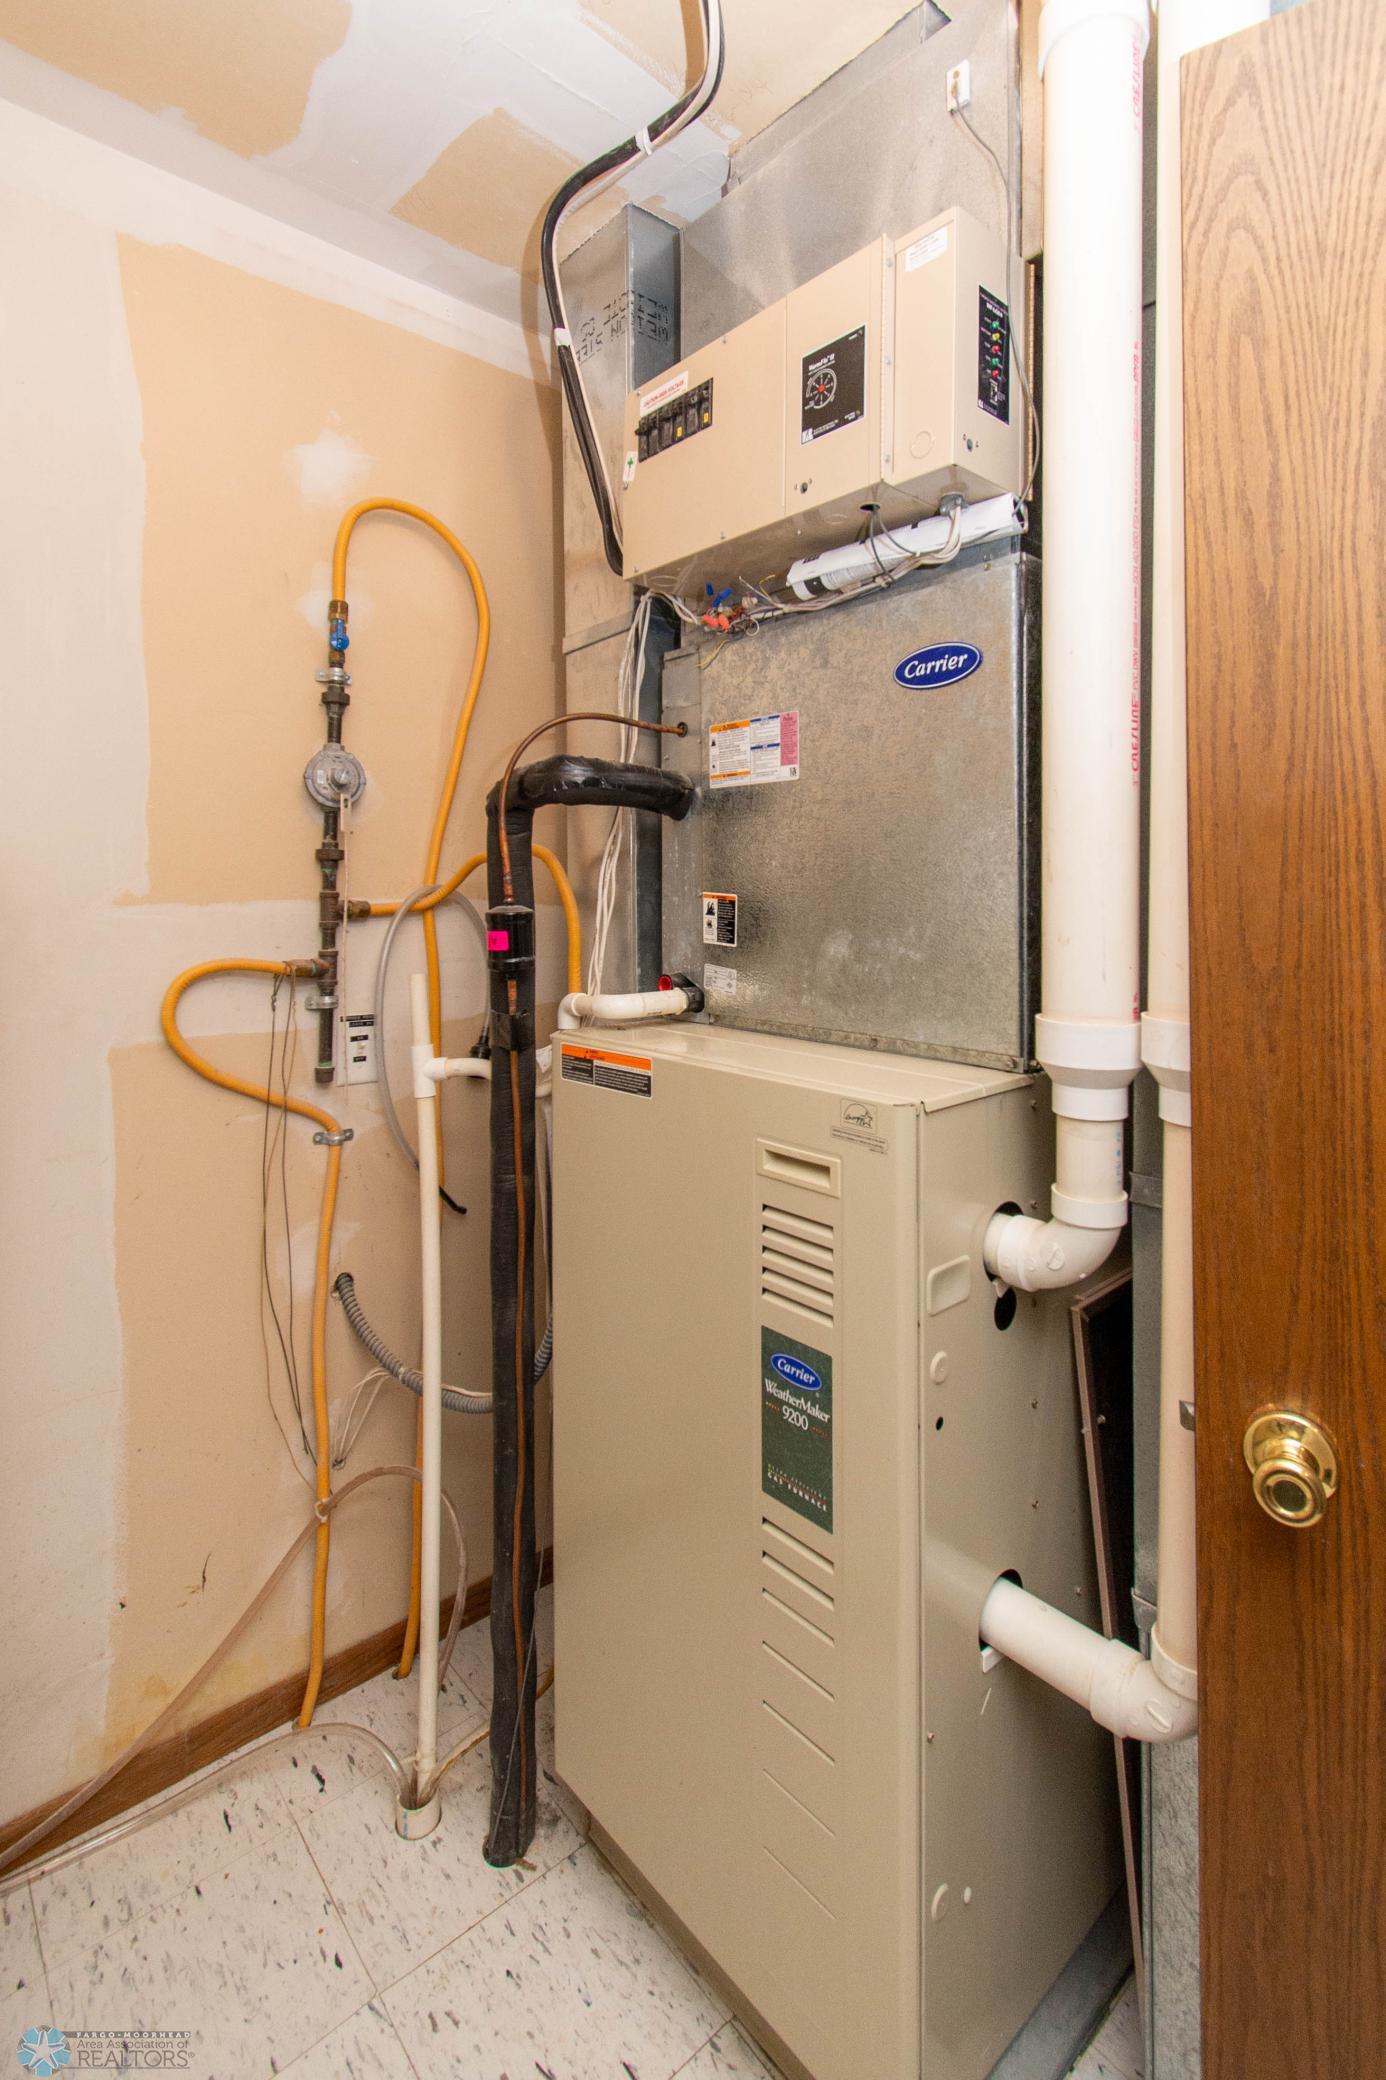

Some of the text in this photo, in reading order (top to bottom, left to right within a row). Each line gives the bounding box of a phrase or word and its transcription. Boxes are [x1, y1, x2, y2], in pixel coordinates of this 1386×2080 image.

[904, 654, 968, 679] Carrier
[777, 1358, 816, 1385] Carrier
[764, 1378, 831, 1423] WeatherMaker
[782, 1405, 809, 1431] 9200
